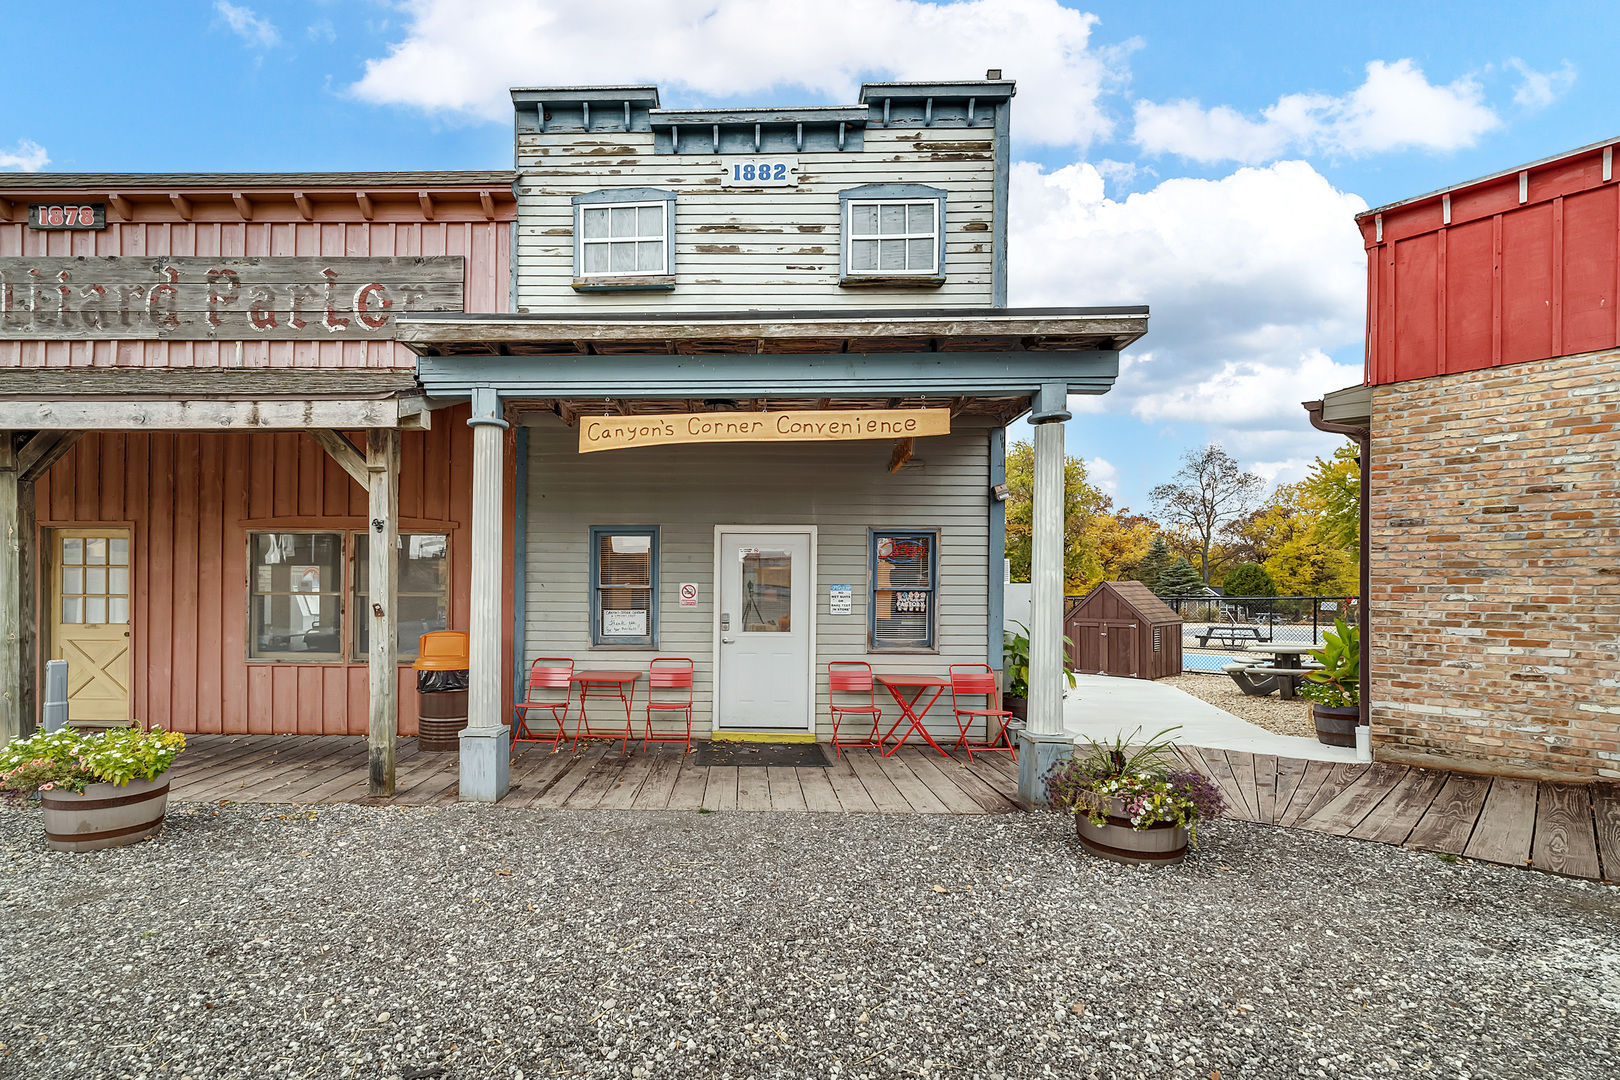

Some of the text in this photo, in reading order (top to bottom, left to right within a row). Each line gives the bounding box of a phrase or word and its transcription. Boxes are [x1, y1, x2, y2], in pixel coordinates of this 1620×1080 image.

[733, 163, 787, 181] 1882
[39, 206, 95, 226] 1878
[587, 415, 917, 442] Canyon's Corner Convenience
[879, 541, 926, 559] Open
